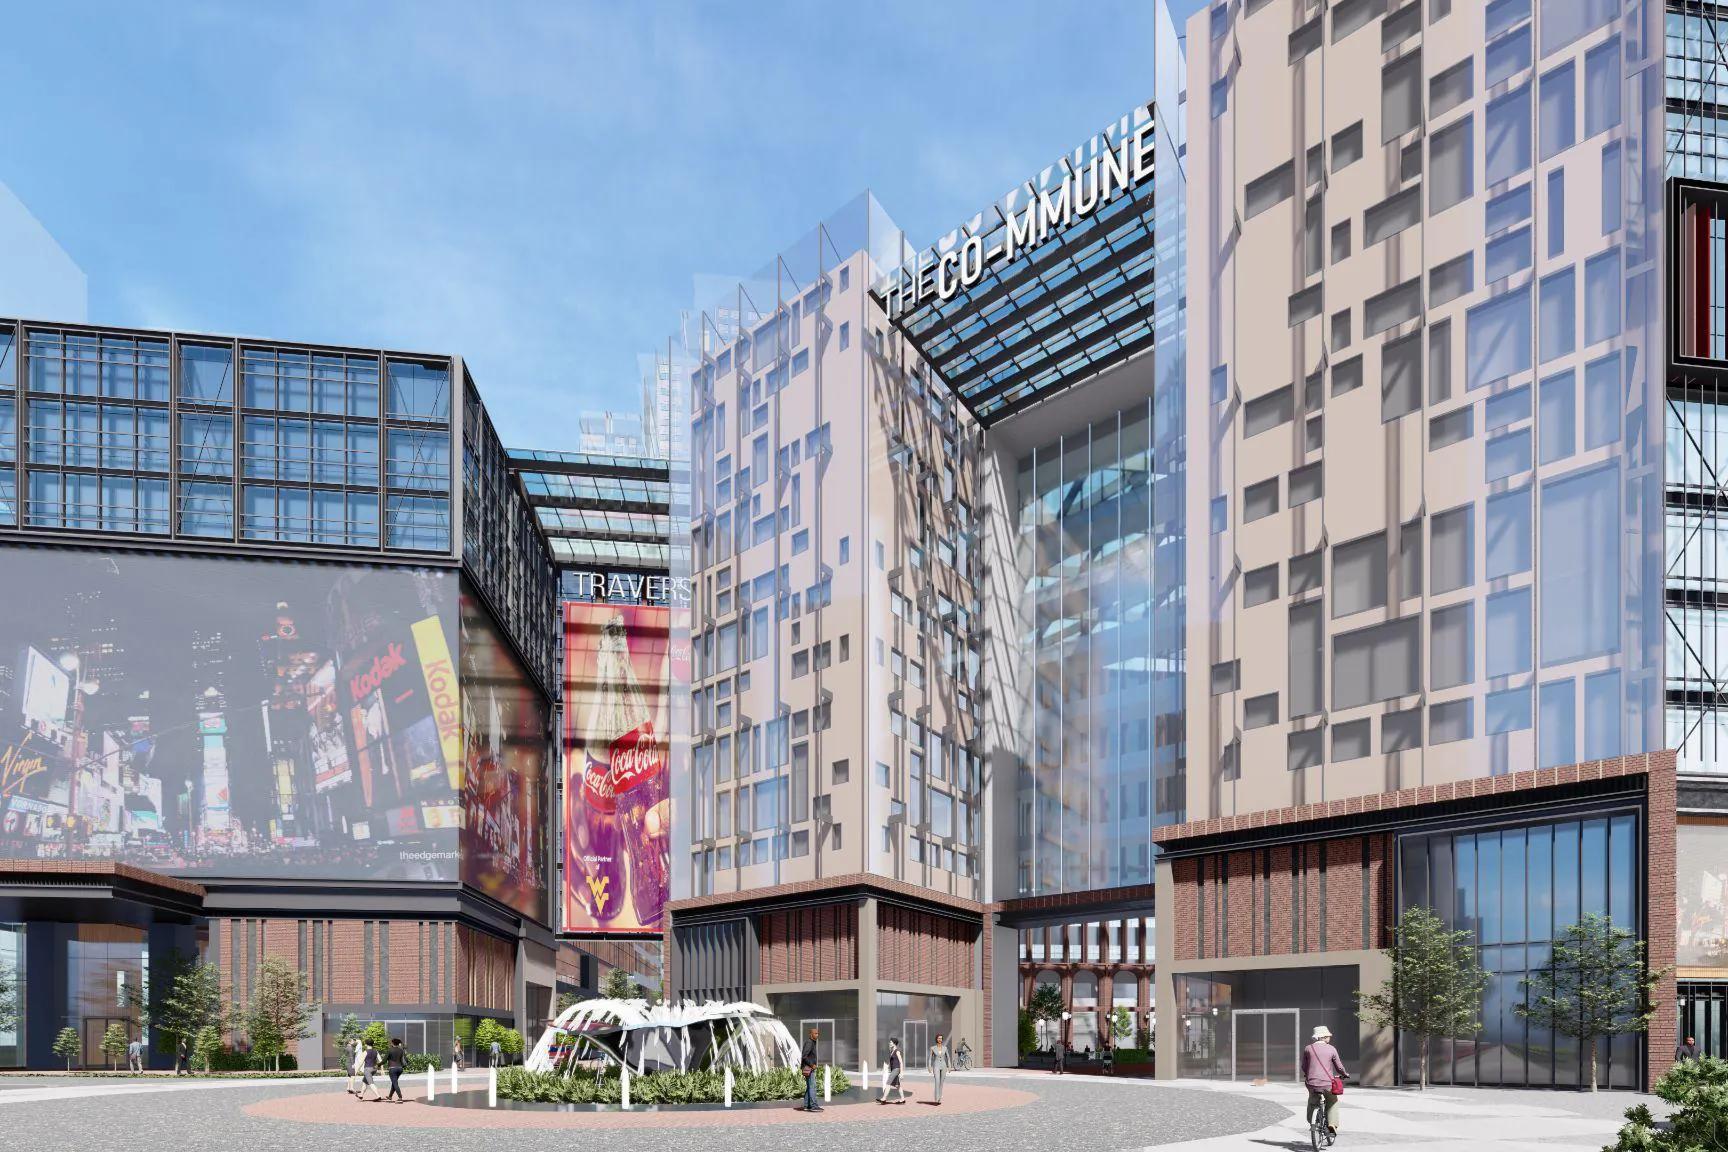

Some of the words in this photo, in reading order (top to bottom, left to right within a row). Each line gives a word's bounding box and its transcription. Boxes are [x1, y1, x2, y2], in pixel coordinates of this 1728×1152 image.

[880, 268, 936, 320] THE
[938, 119, 1155, 301] CO-MMUNE
[350, 642, 407, 701] Kodak
[424, 658, 460, 740] Kodak
[0, 732, 48, 795] Virgin
